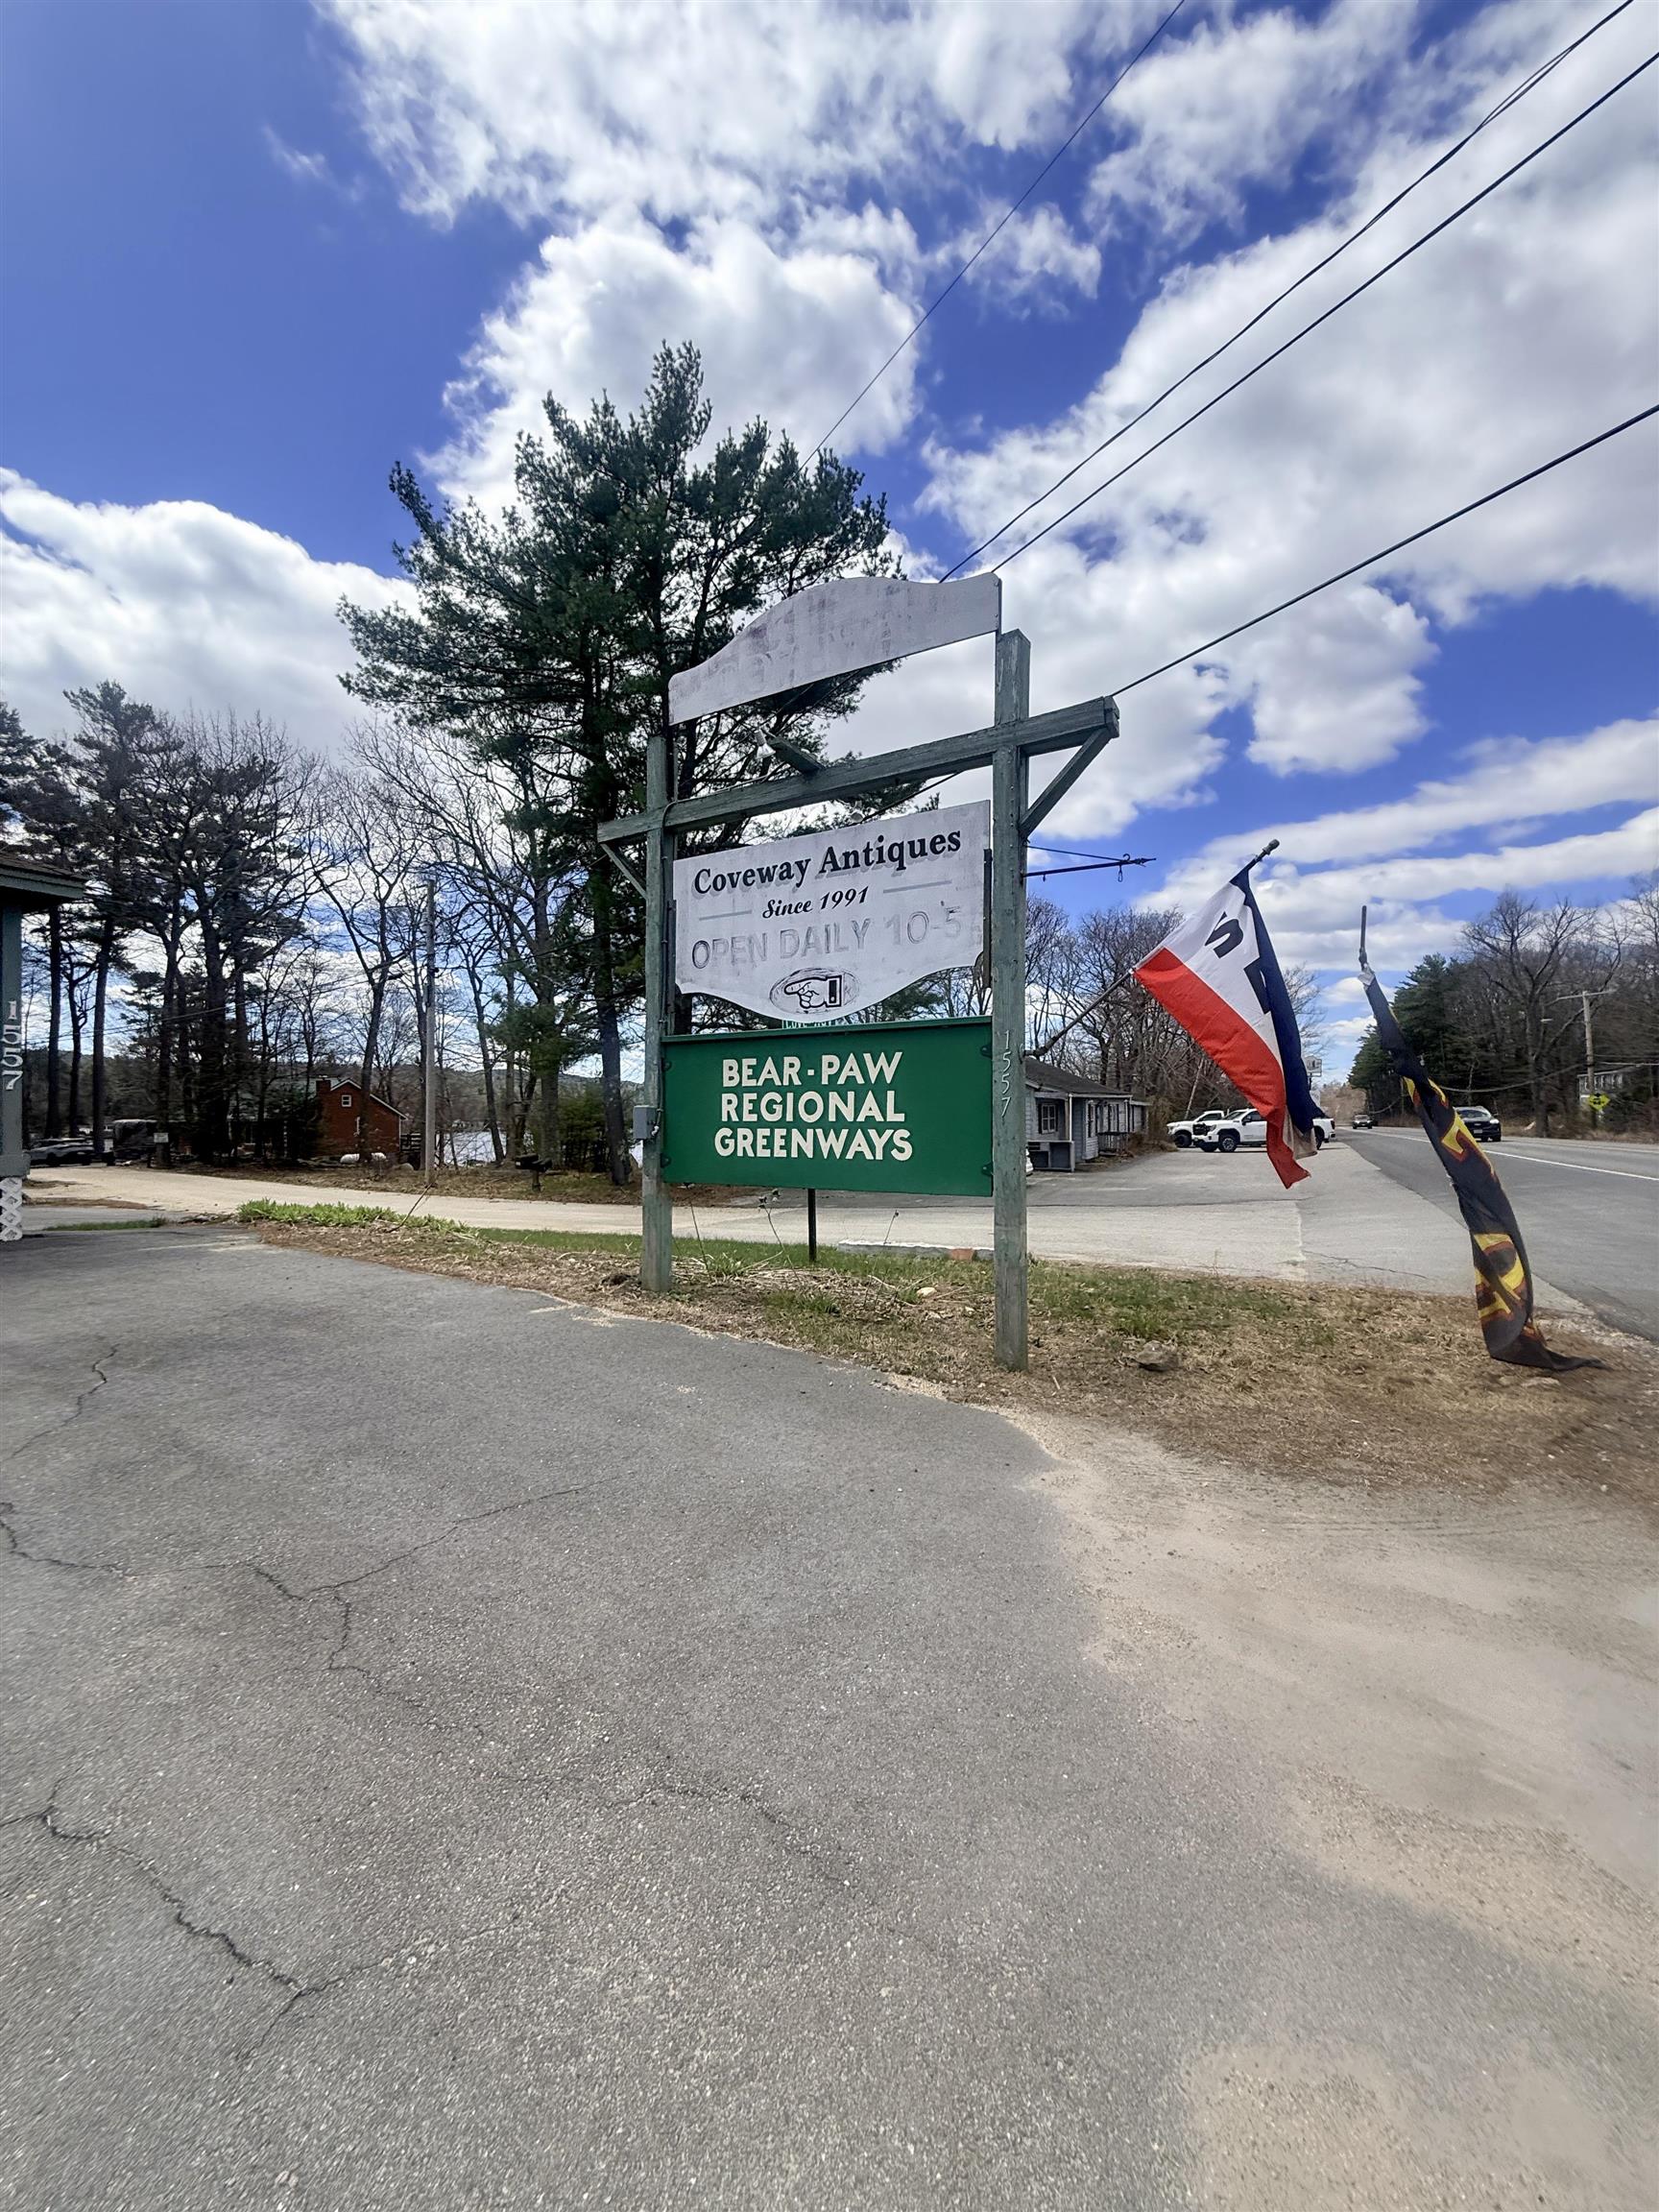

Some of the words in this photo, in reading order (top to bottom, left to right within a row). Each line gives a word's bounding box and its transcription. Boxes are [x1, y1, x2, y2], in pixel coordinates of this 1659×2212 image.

[694, 857, 811, 895] Coveway
[818, 830, 961, 875] Antiques
[762, 899, 813, 919] Since
[819, 885, 869, 911] 1991
[691, 932, 768, 970] OPEN
[780, 918, 872, 960] DAILY
[1, 1000, 24, 1091] 1557
[1000, 1029, 1012, 1118] 1557
[721, 1091, 905, 1123] REGIONAL
[714, 1127, 913, 1162] GREENWAYS
